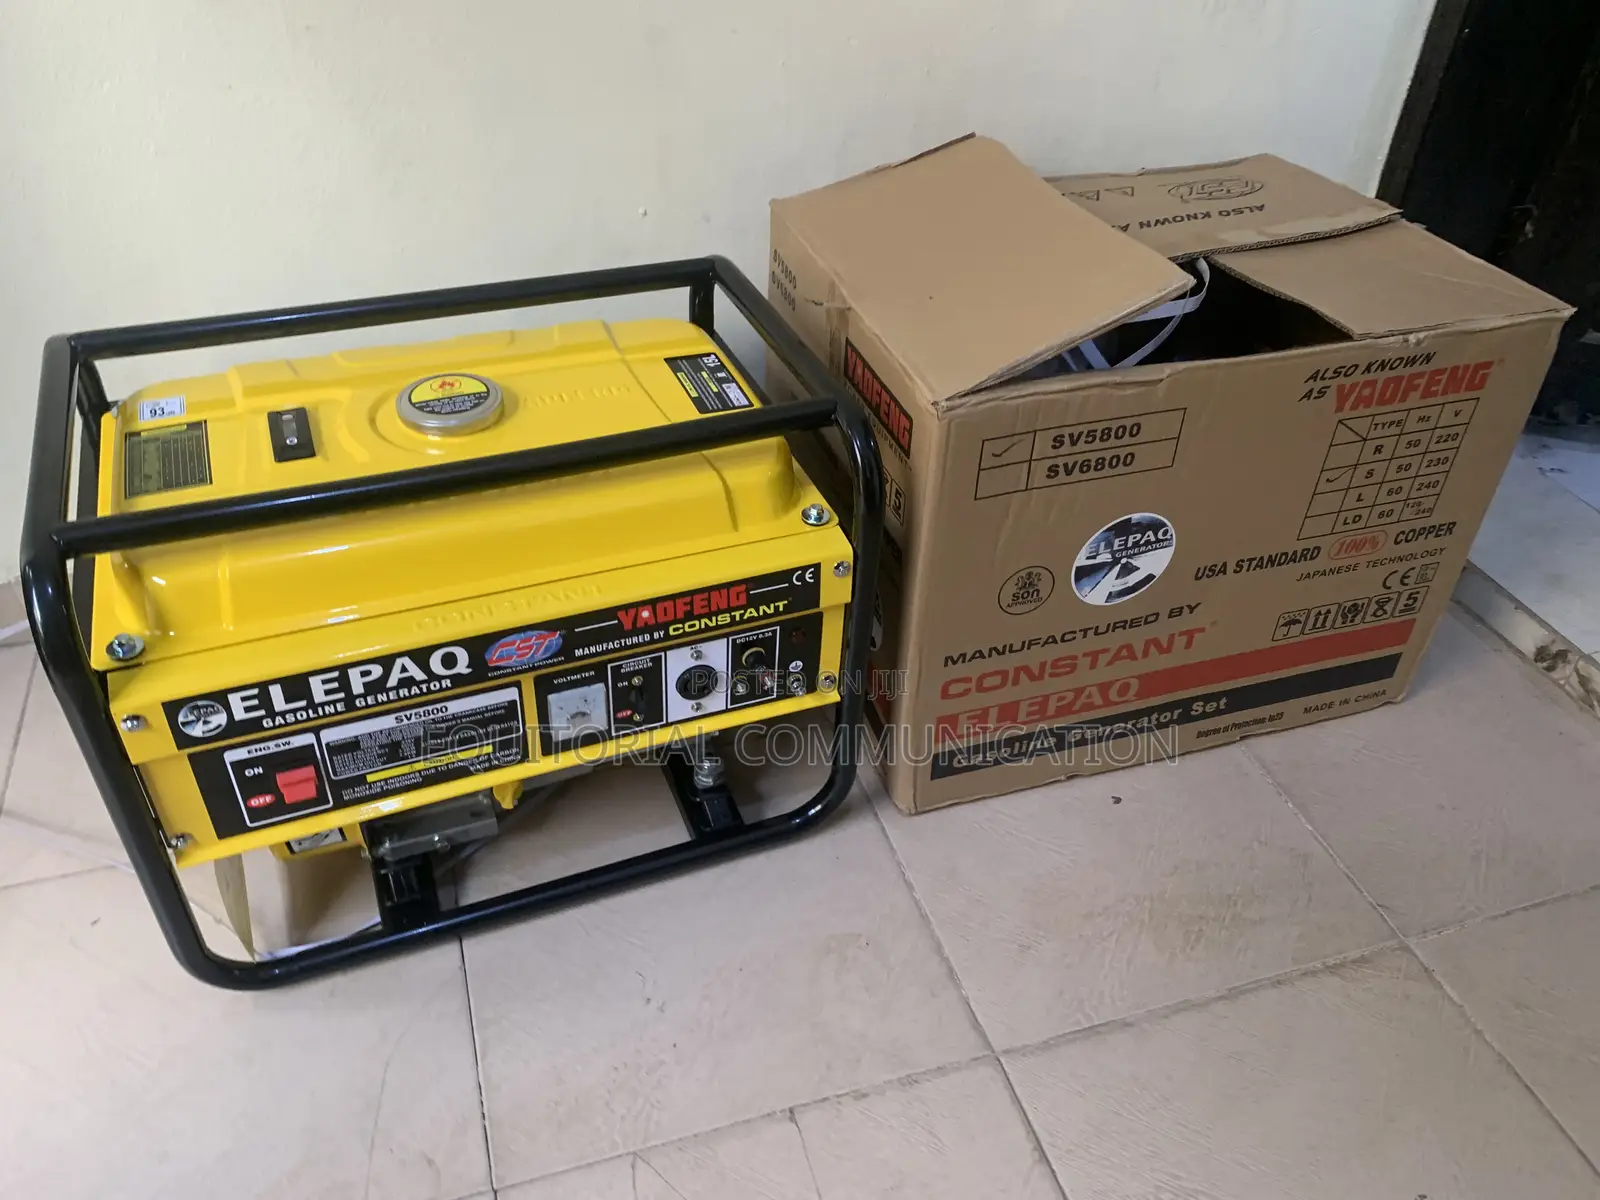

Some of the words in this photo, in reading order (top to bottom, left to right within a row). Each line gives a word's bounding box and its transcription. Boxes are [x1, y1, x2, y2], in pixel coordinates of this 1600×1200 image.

[1139, 211, 1212, 230] KNOWN
[1219, 204, 1266, 218] ALSO
[1303, 363, 1360, 385] ALSO
[1360, 351, 1437, 375] KNOWN
[847, 346, 911, 451] YAOFENG
[1297, 384, 1332, 403] AS
[1334, 360, 1495, 414] YAOFENG
[1372, 418, 1405, 432] TYPE
[1416, 415, 1432, 424] Hz
[1453, 408, 1463, 418] V
[1050, 422, 1142, 450] SV5800
[1372, 444, 1385, 456] R
[1404, 438, 1422, 450] 50
[1434, 432, 1461, 445] 220
[1045, 452, 1136, 480] SV6800
[1364, 468, 1375, 480] S
[1395, 462, 1413, 474] 50
[1425, 456, 1450, 469] 230
[1355, 492, 1365, 503] L
[1386, 486, 1404, 497] 60
[1415, 480, 1441, 492] 240
[1342, 514, 1363, 527] LD
[1377, 509, 1395, 520] 60
[1085, 526, 1174, 558] ELEPAQ
[1195, 566, 1229, 582] USA
[1232, 545, 1322, 574] STANDARD
[1334, 536, 1381, 558] 100%
[1393, 522, 1457, 546] COPPER
[792, 567, 815, 586] CE
[1296, 562, 1361, 582] JAPANESE
[1365, 547, 1447, 569] TECHNOLOGY
[1382, 567, 1417, 590] CE
[617, 584, 748, 631] YAOFENG
[1006, 597, 1043, 609] APPROVED
[574, 633, 651, 658] MANUFACTURED
[653, 630, 665, 641] BY
[669, 600, 788, 637] CONSTANT
[943, 611, 1160, 668] MANUFACTURED
[1167, 602, 1202, 619] BY
[487, 631, 561, 667] CST
[488, 663, 533, 677] CONSTANT
[534, 656, 565, 667] POWER
[622, 658, 651, 669] CIRCUIT
[940, 627, 1206, 700] CONSTANT
[227, 646, 473, 722] ELEPAQ
[553, 670, 596, 685] VOLTMETER
[617, 680, 629, 688] ON
[262, 701, 346, 729] GASOLINE
[355, 679, 452, 708] GENERATOR
[956, 677, 1141, 737] ELEPAQ
[1303, 701, 1336, 715] MADE
[1338, 698, 1351, 707] IN
[1354, 689, 1388, 703] CHINA
[395, 705, 448, 725] SV5800
[952, 734, 1057, 768] Gasoline
[1067, 707, 1182, 741] Generator
[1190, 696, 1228, 716] Set
[1196, 726, 1222, 738] Degree
[1222, 724, 1231, 733] of
[247, 739, 294, 755] ENG.SW.
[244, 766, 264, 778] ON
[354, 784, 370, 793] NOT
[387, 772, 420, 785] INDOORS
[421, 768, 436, 777] DUE
[383, 777, 423, 791] POISONING
[251, 795, 272, 807] OFF
